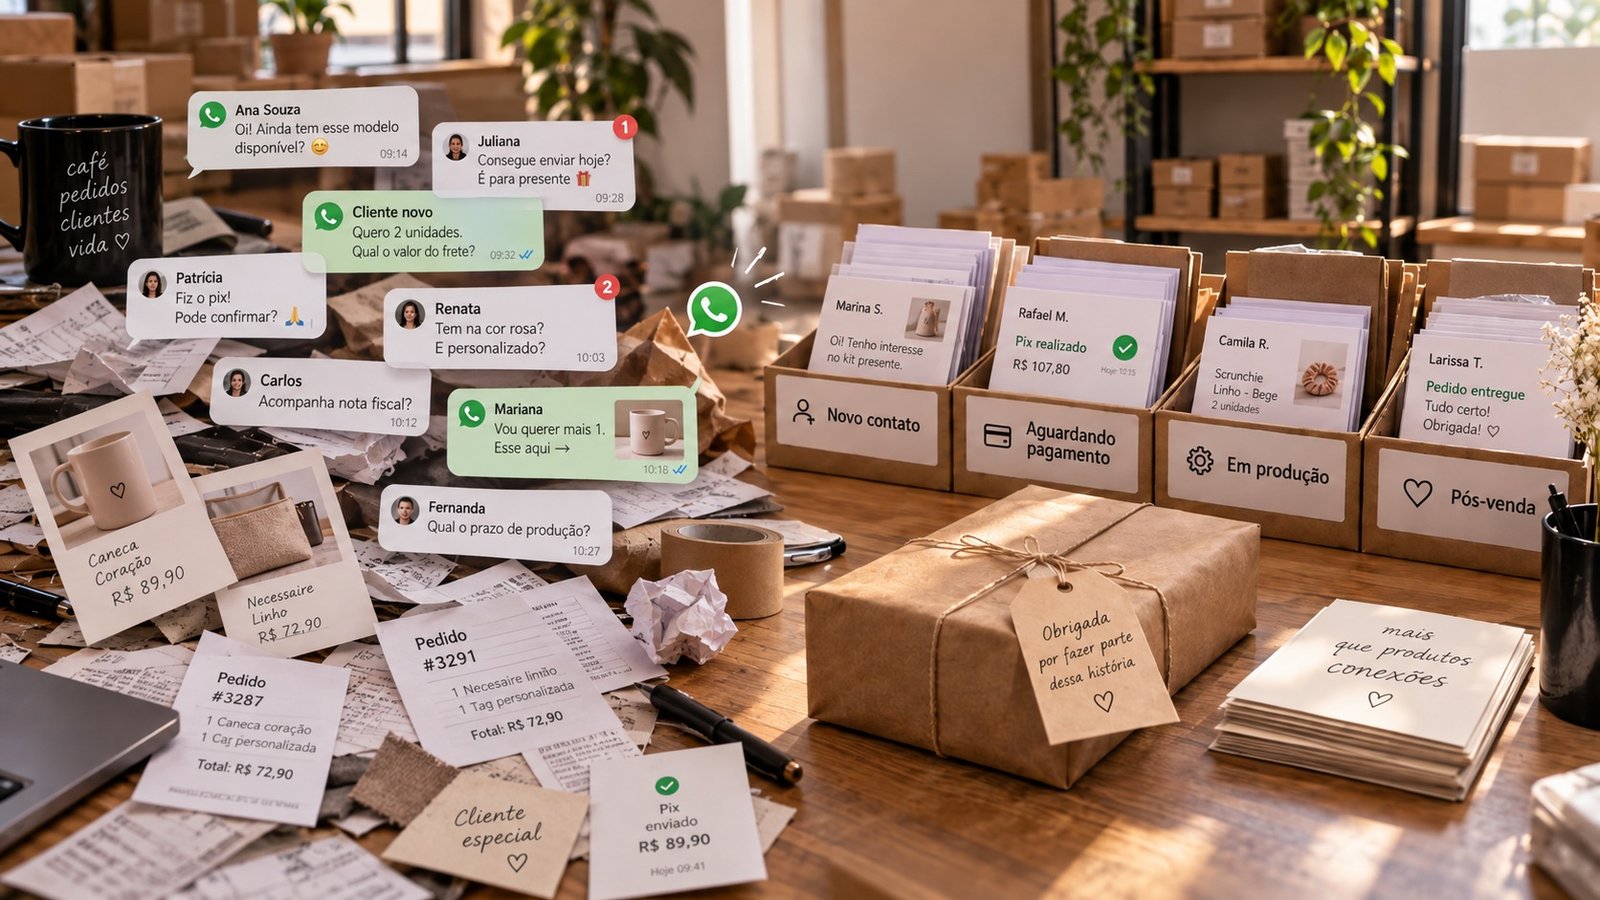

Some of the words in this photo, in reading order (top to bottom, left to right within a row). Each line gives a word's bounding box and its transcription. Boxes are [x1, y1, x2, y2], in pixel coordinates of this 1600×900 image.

[67, 151, 109, 178] café
[60, 176, 127, 212] pedidos
[61, 206, 129, 231] clientes
[69, 233, 108, 257] vida
[836, 300, 870, 313] Marina
[874, 304, 882, 314] S.
[1019, 307, 1052, 320] Rafael
[1056, 311, 1068, 322] M.
[830, 335, 844, 346] Oi!
[848, 337, 877, 350] Tenho
[880, 341, 923, 355] interesse
[1016, 335, 1032, 347] Pix
[1036, 339, 1086, 353] realizado
[1219, 335, 1255, 348] Camila
[1259, 339, 1269, 349] R.
[827, 354, 840, 362] no
[843, 353, 855, 364] kit
[858, 358, 902, 369] presente.
[1013, 359, 1027, 371] R$
[1033, 361, 1070, 375] 107,80
[1430, 353, 1469, 367] Larissa
[1474, 357, 1482, 368] T.
[1215, 368, 1263, 383] Scrunchie
[1214, 384, 1241, 397] Linho
[1253, 388, 1277, 403] Bege
[1427, 381, 1467, 395] Pedido
[1471, 387, 1525, 402] entregue
[1211, 400, 1217, 409] 2
[1221, 402, 1259, 414] unidades
[1426, 400, 1453, 413] Tudo
[1457, 406, 1490, 417] certo!
[828, 407, 862, 425] Novo
[867, 416, 920, 432] contato
[1423, 419, 1481, 435] Obrigada!
[1026, 421, 1115, 445] Aguardando
[1028, 444, 1110, 465] pagamento
[1228, 457, 1250, 474] Em
[1257, 464, 1329, 486] produção
[1452, 489, 1535, 515] Pós-venda
[89, 542, 140, 567] Caneca
[96, 557, 151, 586] Coração
[112, 586, 133, 606] R$
[141, 566, 184, 594] 89,90
[248, 585, 314, 609] Necessaire
[253, 608, 287, 625] Linho
[1043, 610, 1110, 641] Obrigada
[258, 628, 277, 643] R$
[280, 617, 321, 639] 72,90
[415, 630, 467, 650] Pedido
[1382, 628, 1433, 640] mais
[424, 650, 475, 671] #3291
[1039, 655, 1058, 674] por
[1064, 645, 1094, 665] fazer
[1101, 632, 1133, 656] parte
[1333, 642, 1371, 656] que
[1376, 648, 1471, 666] produtos
[218, 672, 266, 688] Pedido
[1050, 674, 1083, 690] dessa
[1088, 657, 1135, 679] história
[1327, 663, 1446, 687] conexões
[452, 688, 458, 697] 1
[463, 676, 523, 695] Necesaire
[459, 705, 466, 714] 1
[470, 701, 494, 711] Tag
[497, 679, 574, 709] personalizada
[212, 691, 263, 706] #3287
[207, 715, 213, 725] 1
[218, 717, 260, 730] Caneca
[264, 724, 311, 736] coração
[507, 719, 524, 731] R$
[527, 711, 563, 727] 72,90
[202, 732, 207, 742] 1
[235, 738, 316, 753] personalizada
[199, 759, 231, 772] Total:
[235, 764, 251, 776] R$
[257, 766, 293, 780] 72,90
[455, 806, 526, 826] Cliente
[660, 803, 679, 814] Pix
[646, 816, 698, 831] enviado
[463, 822, 541, 853] especial
[639, 839, 659, 852] R$
[666, 834, 710, 849] 89,90
[651, 867, 674, 877] Hoje
[677, 862, 705, 873] 09:41
